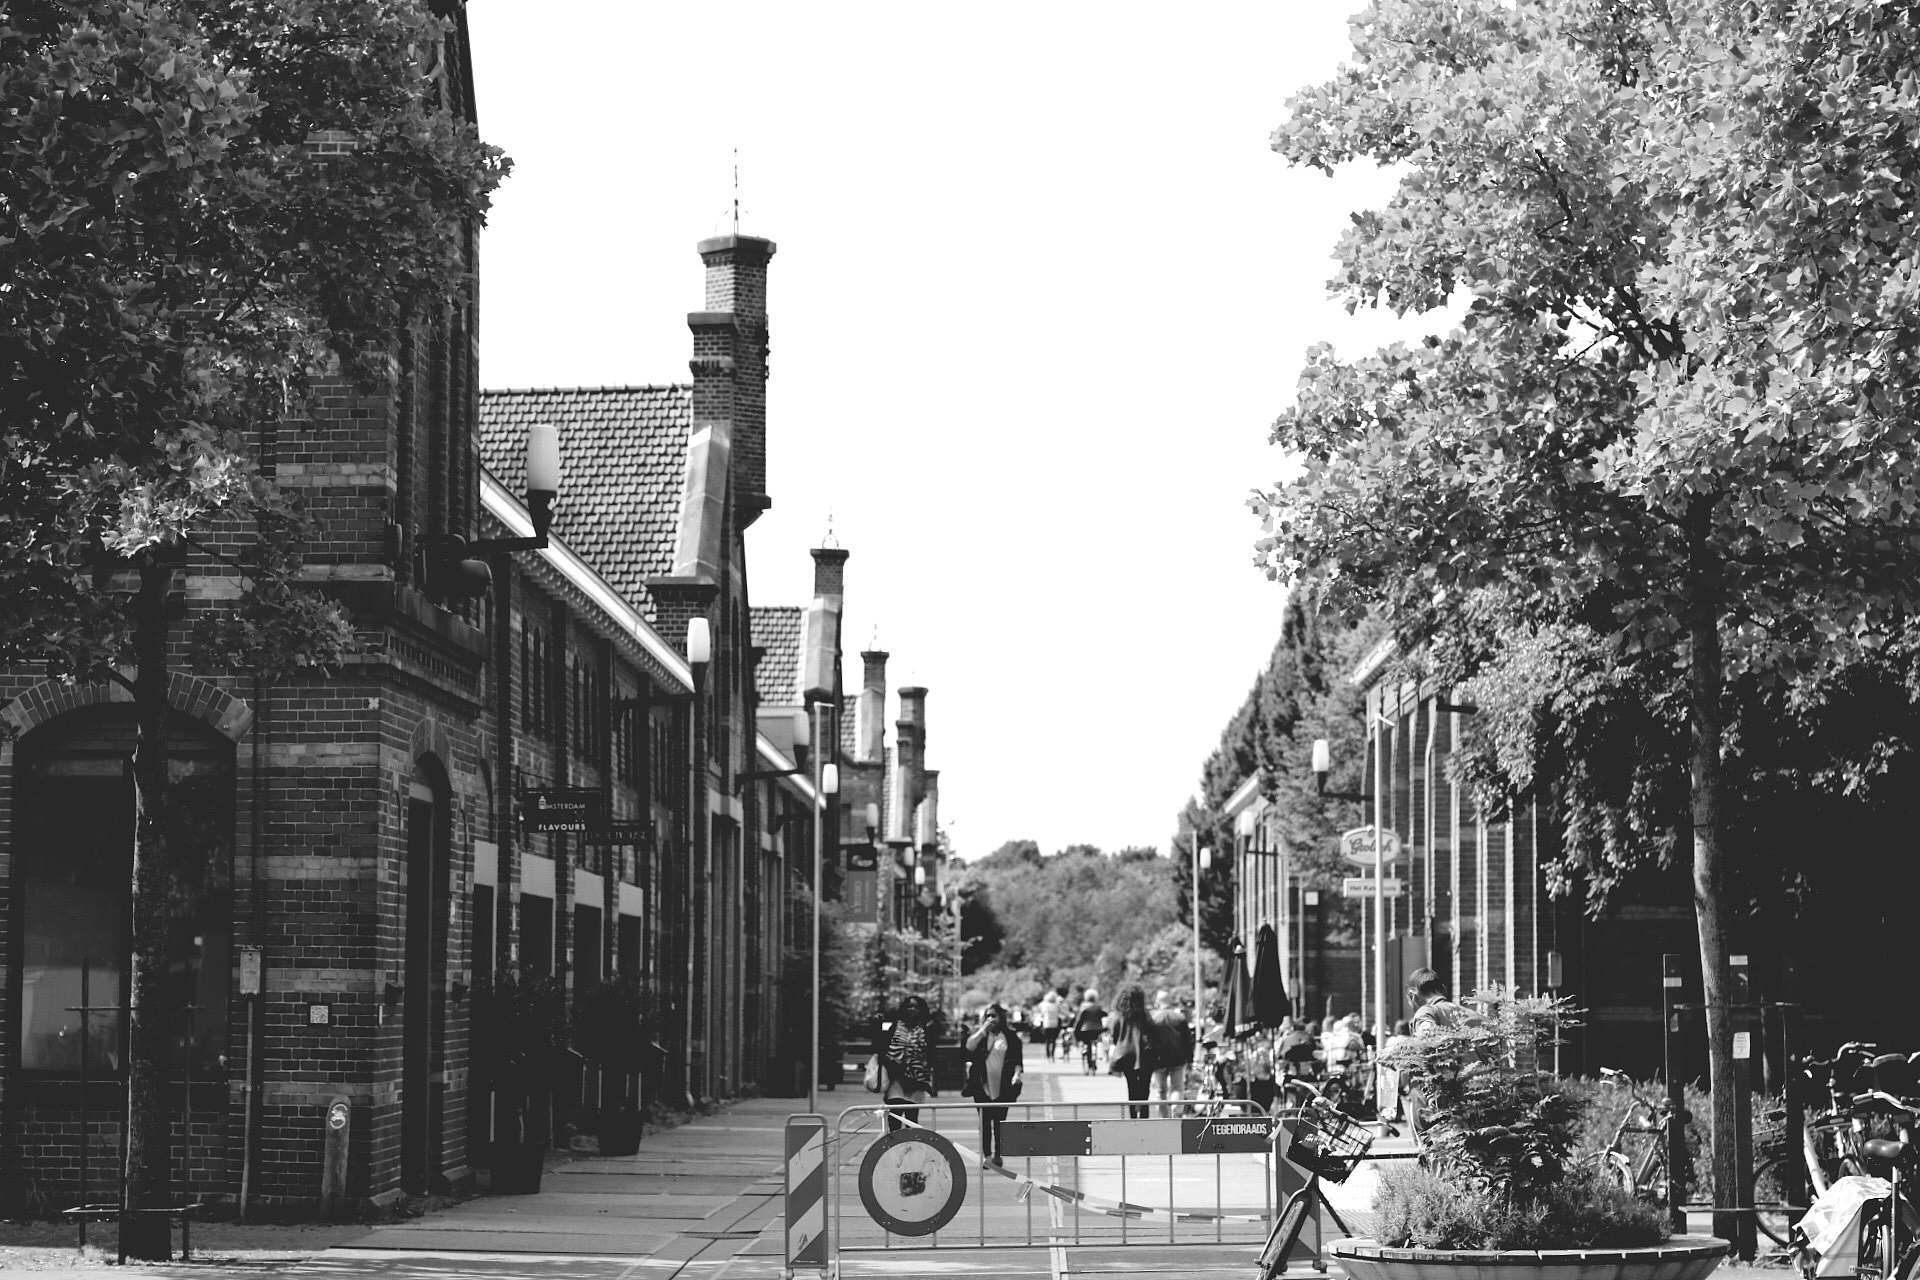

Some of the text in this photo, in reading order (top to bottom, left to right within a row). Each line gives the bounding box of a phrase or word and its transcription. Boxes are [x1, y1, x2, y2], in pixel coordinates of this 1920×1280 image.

[538, 823, 586, 831] FLAVOURS
[1349, 838, 1393, 855] Grolh
[1211, 1123, 1267, 1135] TEGENDRAADS
